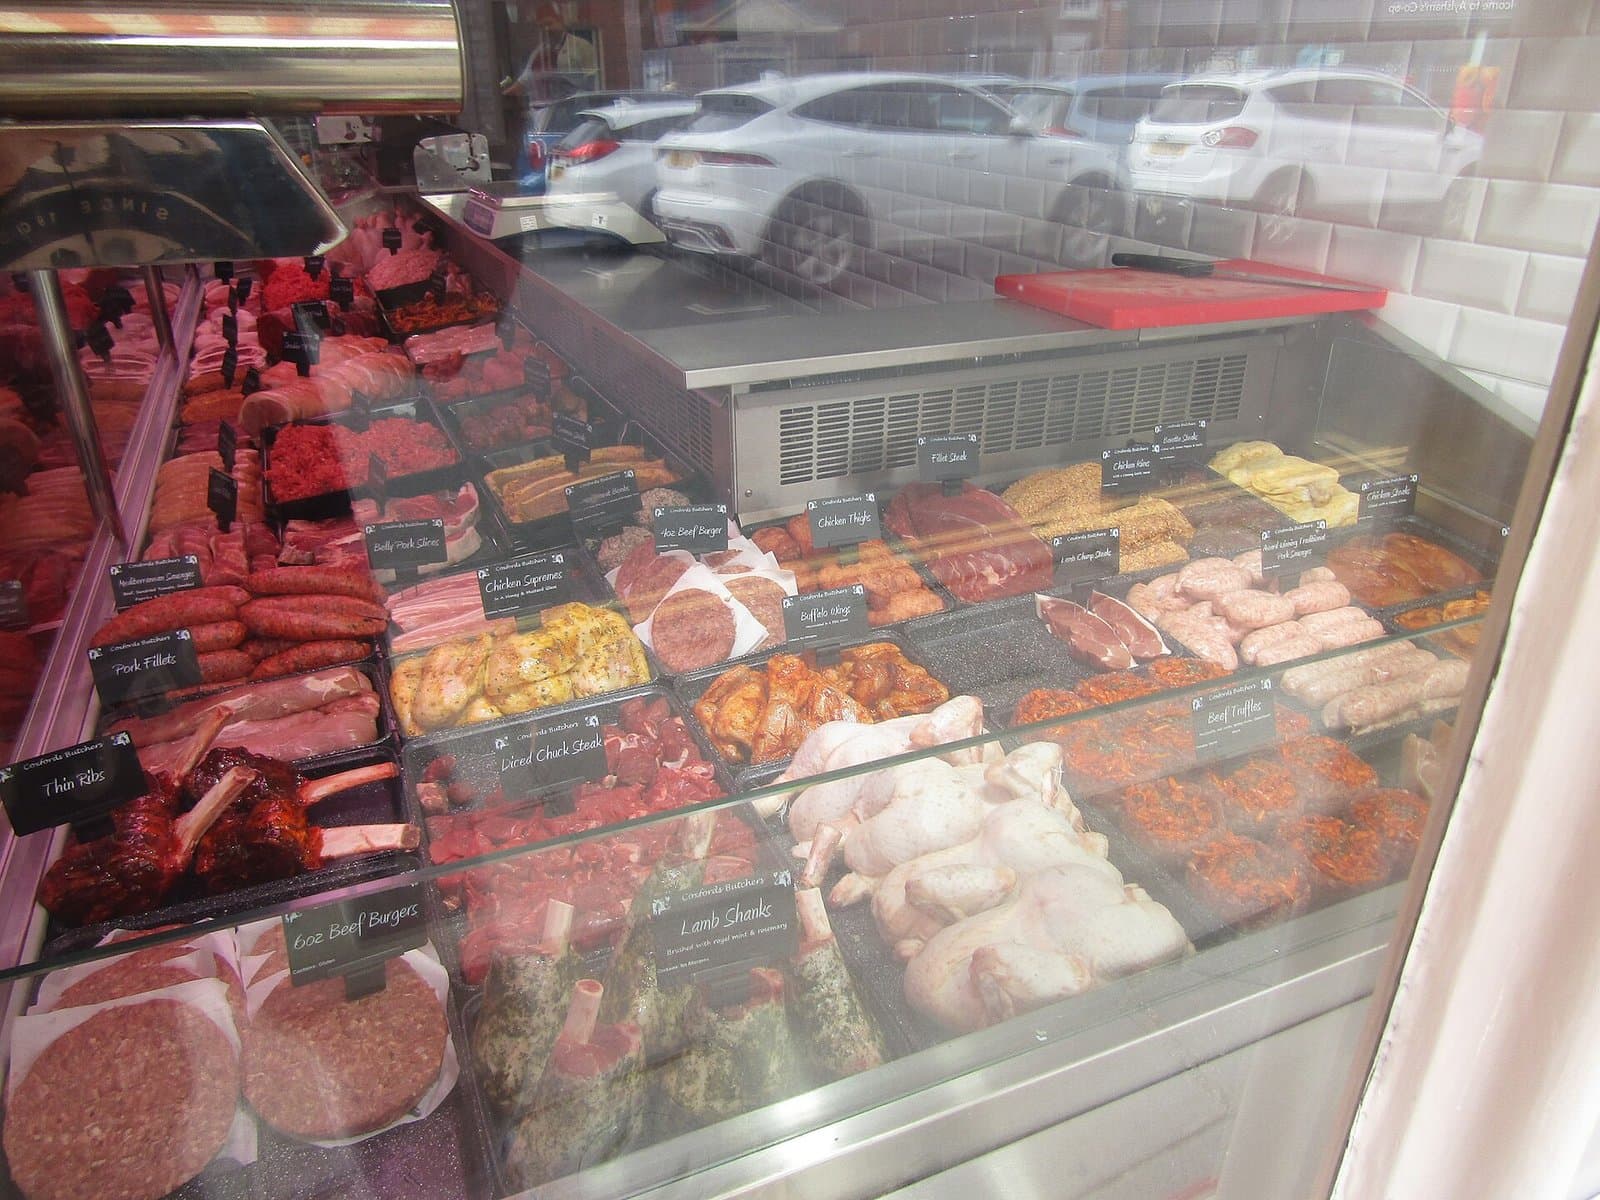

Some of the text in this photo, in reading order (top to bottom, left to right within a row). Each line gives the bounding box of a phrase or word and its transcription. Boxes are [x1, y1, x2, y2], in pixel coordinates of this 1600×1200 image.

[949, 450, 967, 463] Steak
[1113, 460, 1135, 470] Chicken
[818, 510, 872, 528] Chicken Thighs
[660, 524, 722, 540] 4oz Beef Burger
[374, 536, 440, 552] Belly Pork Slices
[485, 571, 563, 593] Chicken Supremes
[801, 604, 851, 623] Buffalo Wings
[111, 652, 177, 676] Pork Fillets
[1207, 697, 1262, 724] Beef Truffles
[64, 741, 104, 759] Butchers
[501, 732, 603, 772] Diced Chuck Steak
[41, 767, 105, 797] Thin Ribs
[725, 877, 765, 893] Butchers
[294, 902, 419, 950] 6oz Beef Burgers
[681, 897, 773, 936] Lamb Shanks
[667, 943, 694, 957] Brushed
[695, 939, 712, 949] with
[713, 935, 731, 946] royal
[732, 930, 748, 940] mint
[758, 922, 788, 936] rosemary
